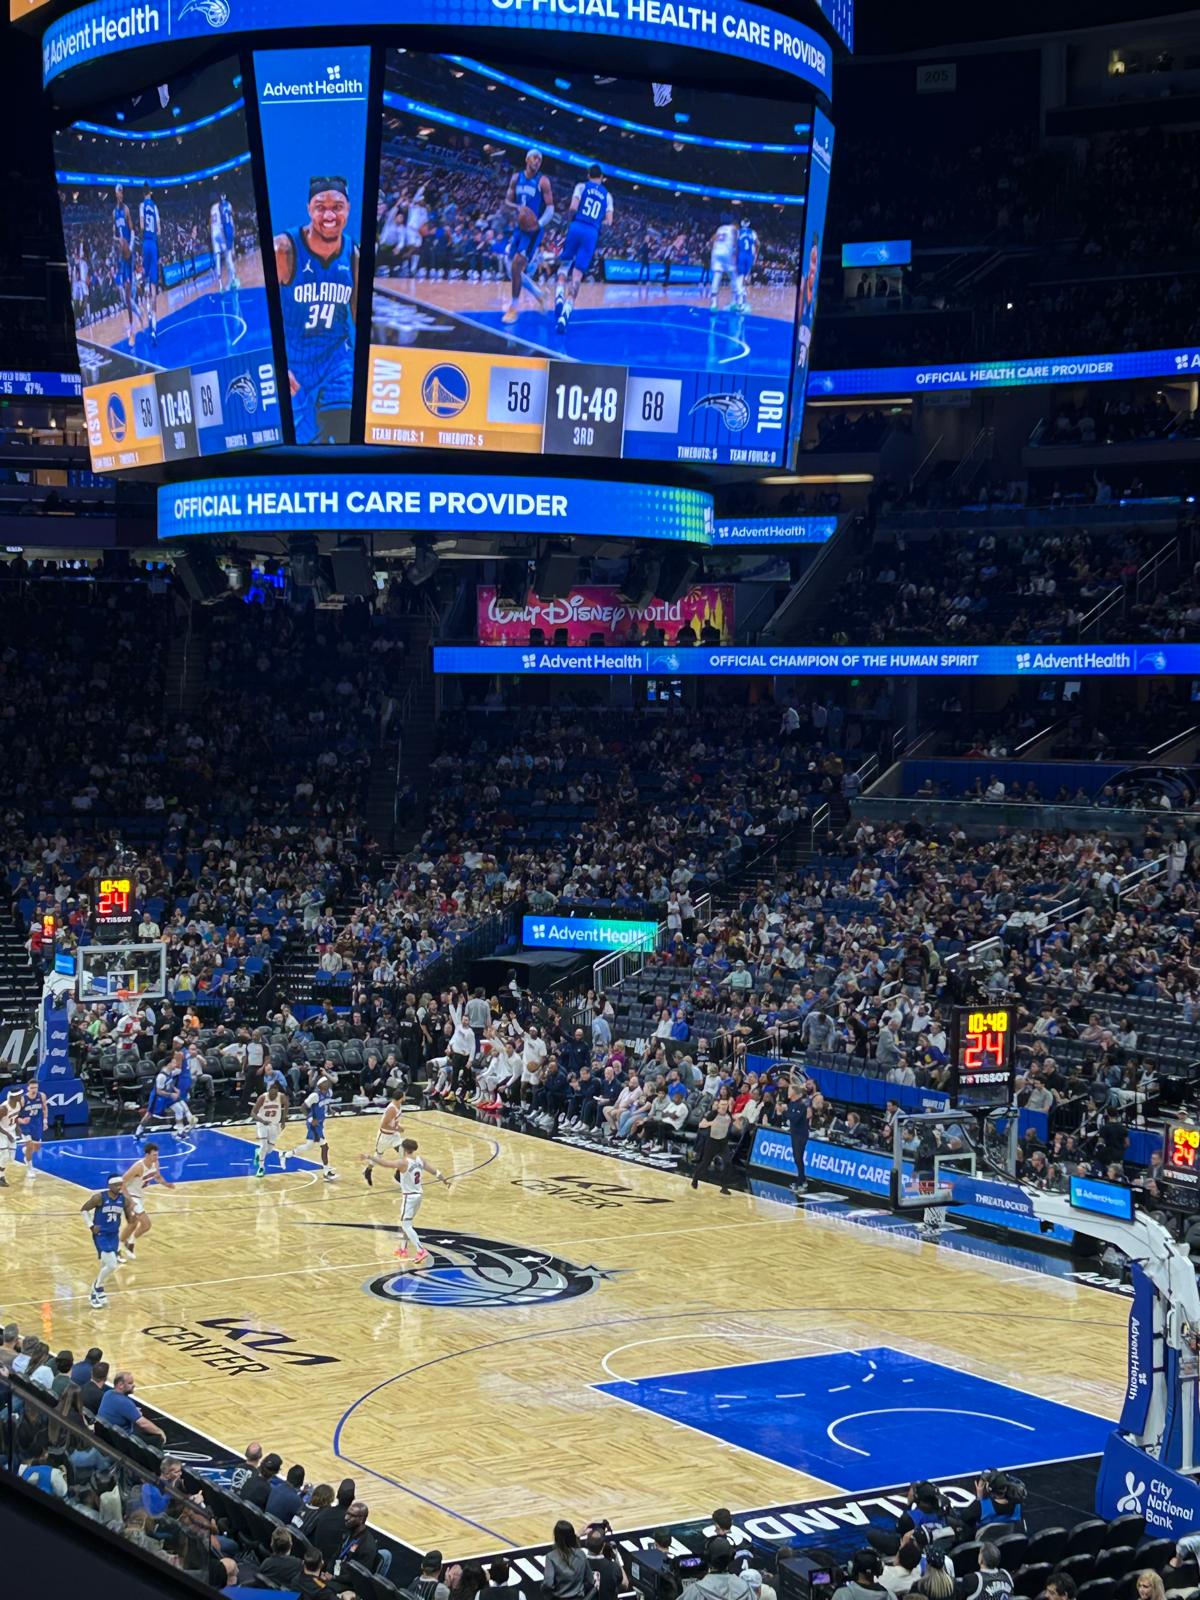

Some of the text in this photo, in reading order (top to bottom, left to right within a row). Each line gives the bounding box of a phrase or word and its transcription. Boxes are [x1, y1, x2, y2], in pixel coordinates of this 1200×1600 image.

[50, 4, 159, 67] AdventHealth
[627, 0, 716, 34] HEALTH
[722, 15, 770, 48] CARE
[774, 28, 826, 77] PROVIDER
[925, 70, 949, 82] 205
[263, 79, 362, 97] AdventHealth
[582, 196, 602, 220] 50
[294, 281, 352, 304] ORLANDO
[305, 303, 335, 329] 34
[915, 362, 1113, 384] OFFICIAL HEALTH CARE PROVIDER
[258, 363, 277, 412] ORL
[371, 359, 402, 415] GSW
[507, 381, 531, 413] 58
[160, 389, 192, 427] 10:48
[201, 384, 214, 417] 68
[555, 383, 618, 424] 10:48
[642, 390, 664, 421] 68
[756, 389, 785, 434] ORL
[86, 398, 103, 446] GSW
[140, 397, 153, 428] 58
[371, 427, 391, 440] TEAM
[438, 431, 476, 446] TIMEOUTS:
[573, 426, 594, 446] 3RD
[677, 445, 711, 460] TIMEOUTS:
[730, 449, 747, 461] TEAM
[174, 490, 567, 519] OFFICIAL HEALTH CARE PROVIDER
[730, 525, 805, 538] AdventHealth
[539, 654, 642, 669] AdventHealth
[709, 654, 980, 667] OFFICIAL CHAMPION OF THE HUMAN SPIRIT
[1032, 652, 1130, 669] AdventHealth
[98, 892, 128, 913] 24
[548, 925, 648, 944] AdventHealth
[968, 1012, 1008, 1033] 10:48
[965, 1033, 1004, 1068] 24
[974, 1071, 1010, 1084] TISSOT
[1173, 1144, 1195, 1166] 24
[414, 1171, 421, 1185] 2
[810, 1152, 856, 1177] HEALTH
[857, 1164, 891, 1185] CARE
[511, 1179, 624, 1209] CENTER
[140, 1325, 270, 1376] CENTER
[1128, 1316, 1141, 1400] AdventHealth
[1150, 1478, 1173, 1501] City
[1147, 1494, 1194, 1521] National
[1145, 1508, 1173, 1531] Bank
